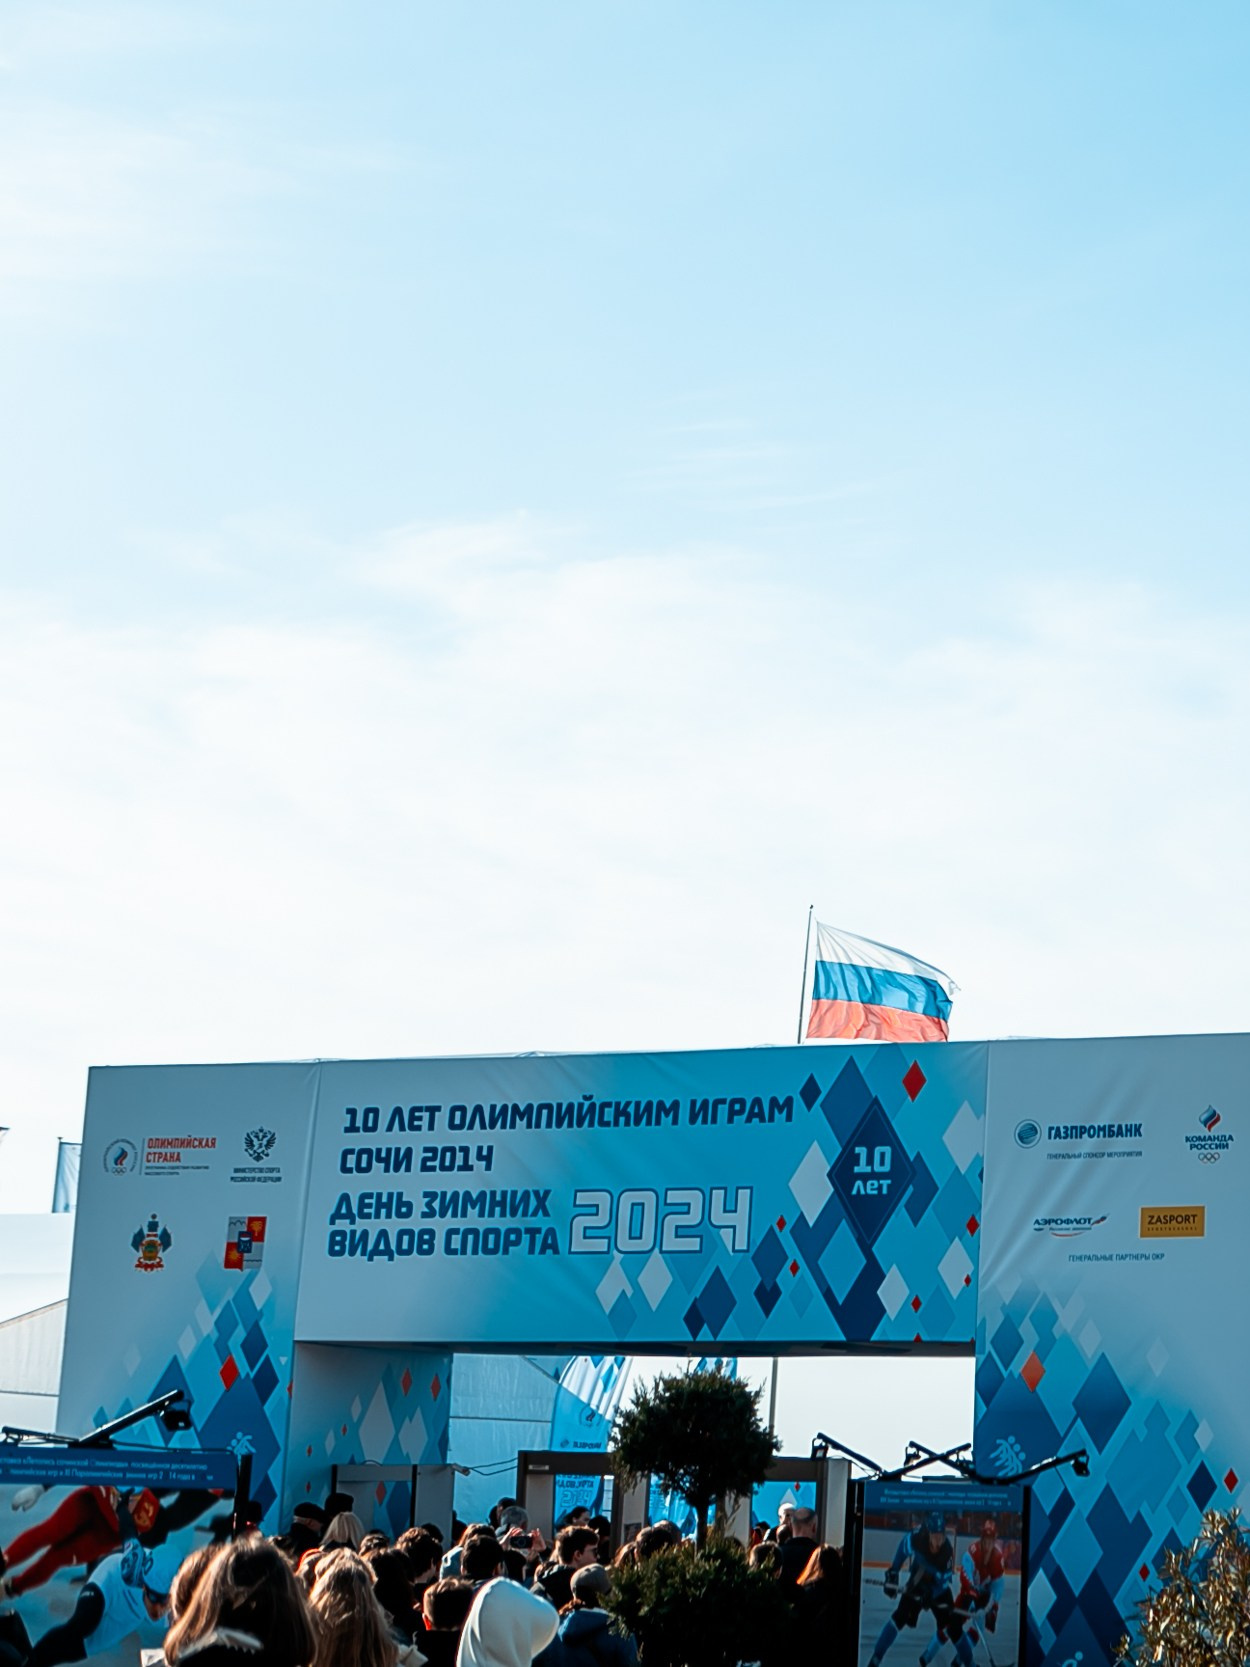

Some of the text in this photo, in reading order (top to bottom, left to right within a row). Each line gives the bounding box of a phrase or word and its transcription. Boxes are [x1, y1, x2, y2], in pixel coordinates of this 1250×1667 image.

[344, 1094, 795, 1134] 10 ЛЕТ ОЛИМПИЙСКИМ ИГРАМ
[1047, 1123, 1143, 1141] ГАЗПРОМБАНК
[1184, 1134, 1234, 1143] КОМАНДА
[147, 1134, 217, 1150] ОЛИМПИЙСКАЯ
[1189, 1142, 1230, 1151] РОССИИ
[146, 1151, 181, 1164] СТРАНА
[339, 1145, 494, 1174] СОЧИ 2014
[853, 1145, 892, 1174] 10
[851, 1179, 892, 1196] лет
[329, 1189, 552, 1227] ДЕНЬ ЗИМНИХ
[568, 1185, 754, 1256] 2024
[1033, 1217, 1093, 1226] АЭРОФЛОТ
[1147, 1214, 1198, 1225] ZASPORT
[327, 1226, 560, 1262] ВИДОВ СПОРТА
[1068, 1253, 1114, 1262] ГЕНЕРАЛЬНЫЕ
[1115, 1252, 1151, 1261] ПАРТНЕРЫ
